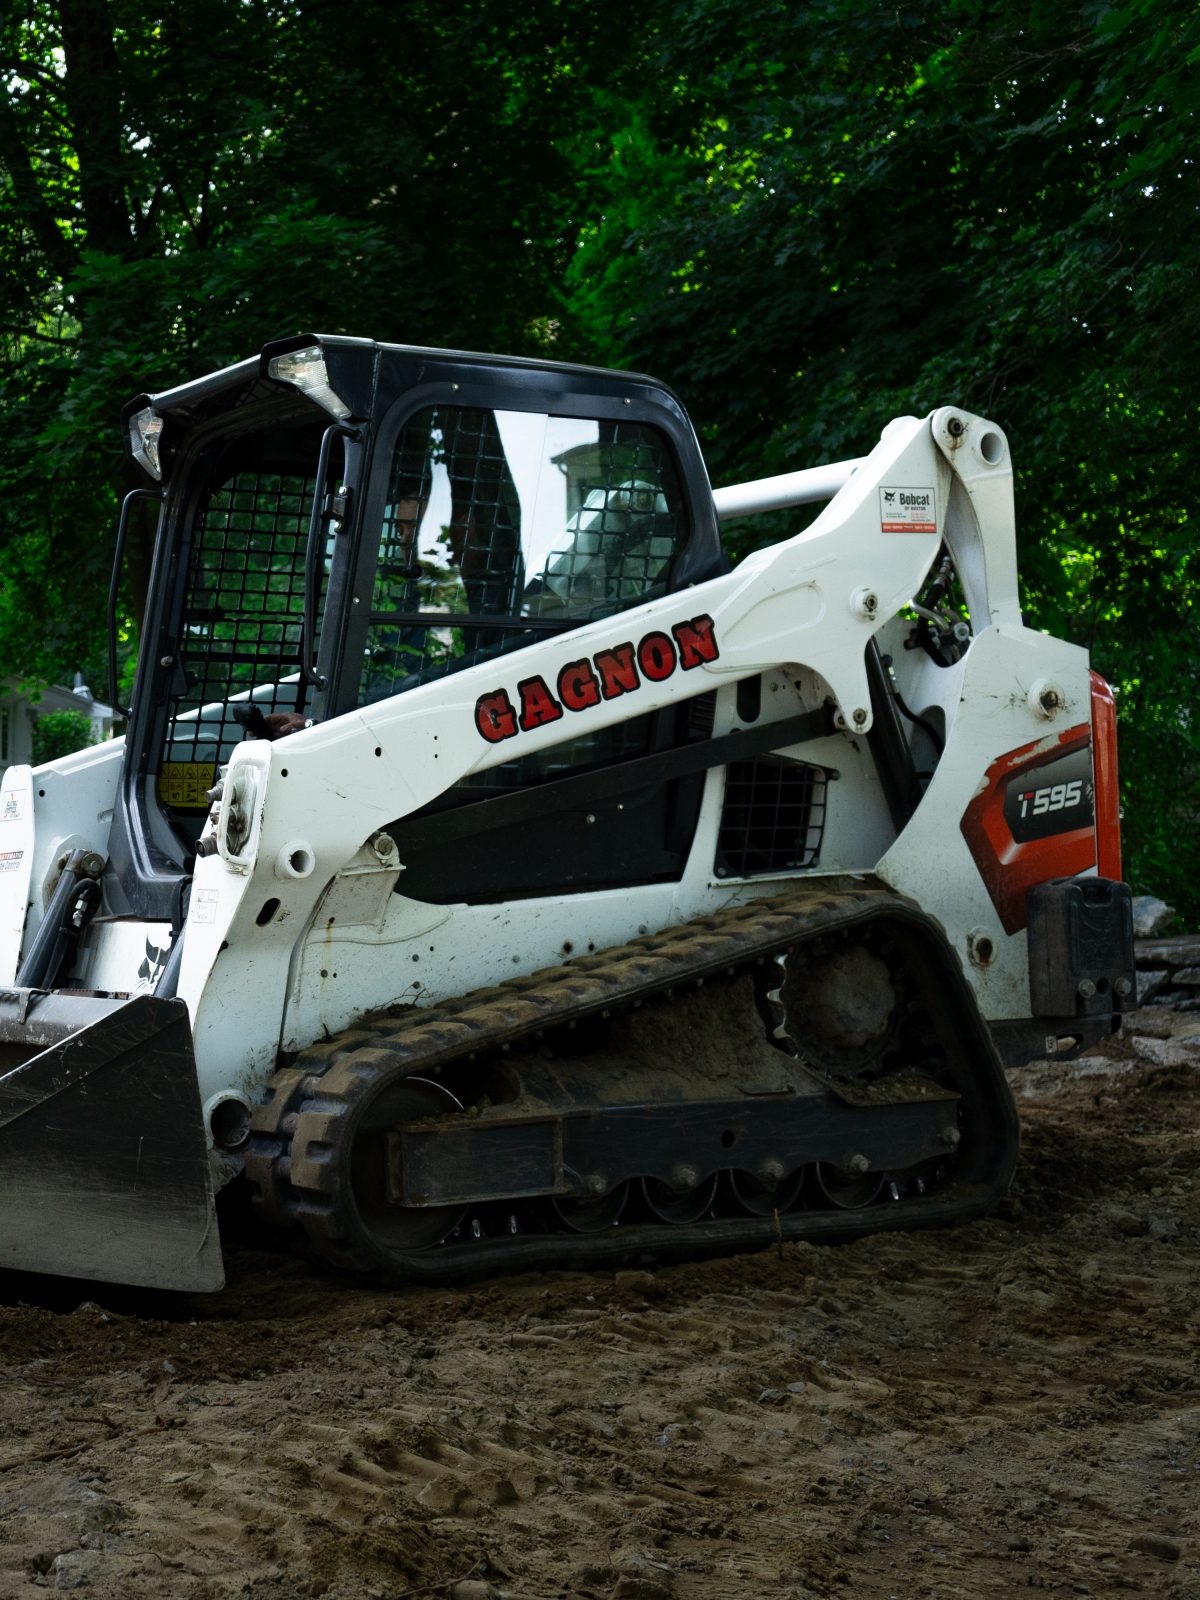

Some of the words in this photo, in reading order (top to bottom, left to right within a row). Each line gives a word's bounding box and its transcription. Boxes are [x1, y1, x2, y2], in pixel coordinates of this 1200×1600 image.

[899, 493, 930, 505] Bobcat
[474, 613, 719, 744] GAGNON
[1018, 780, 1083, 818] T595
